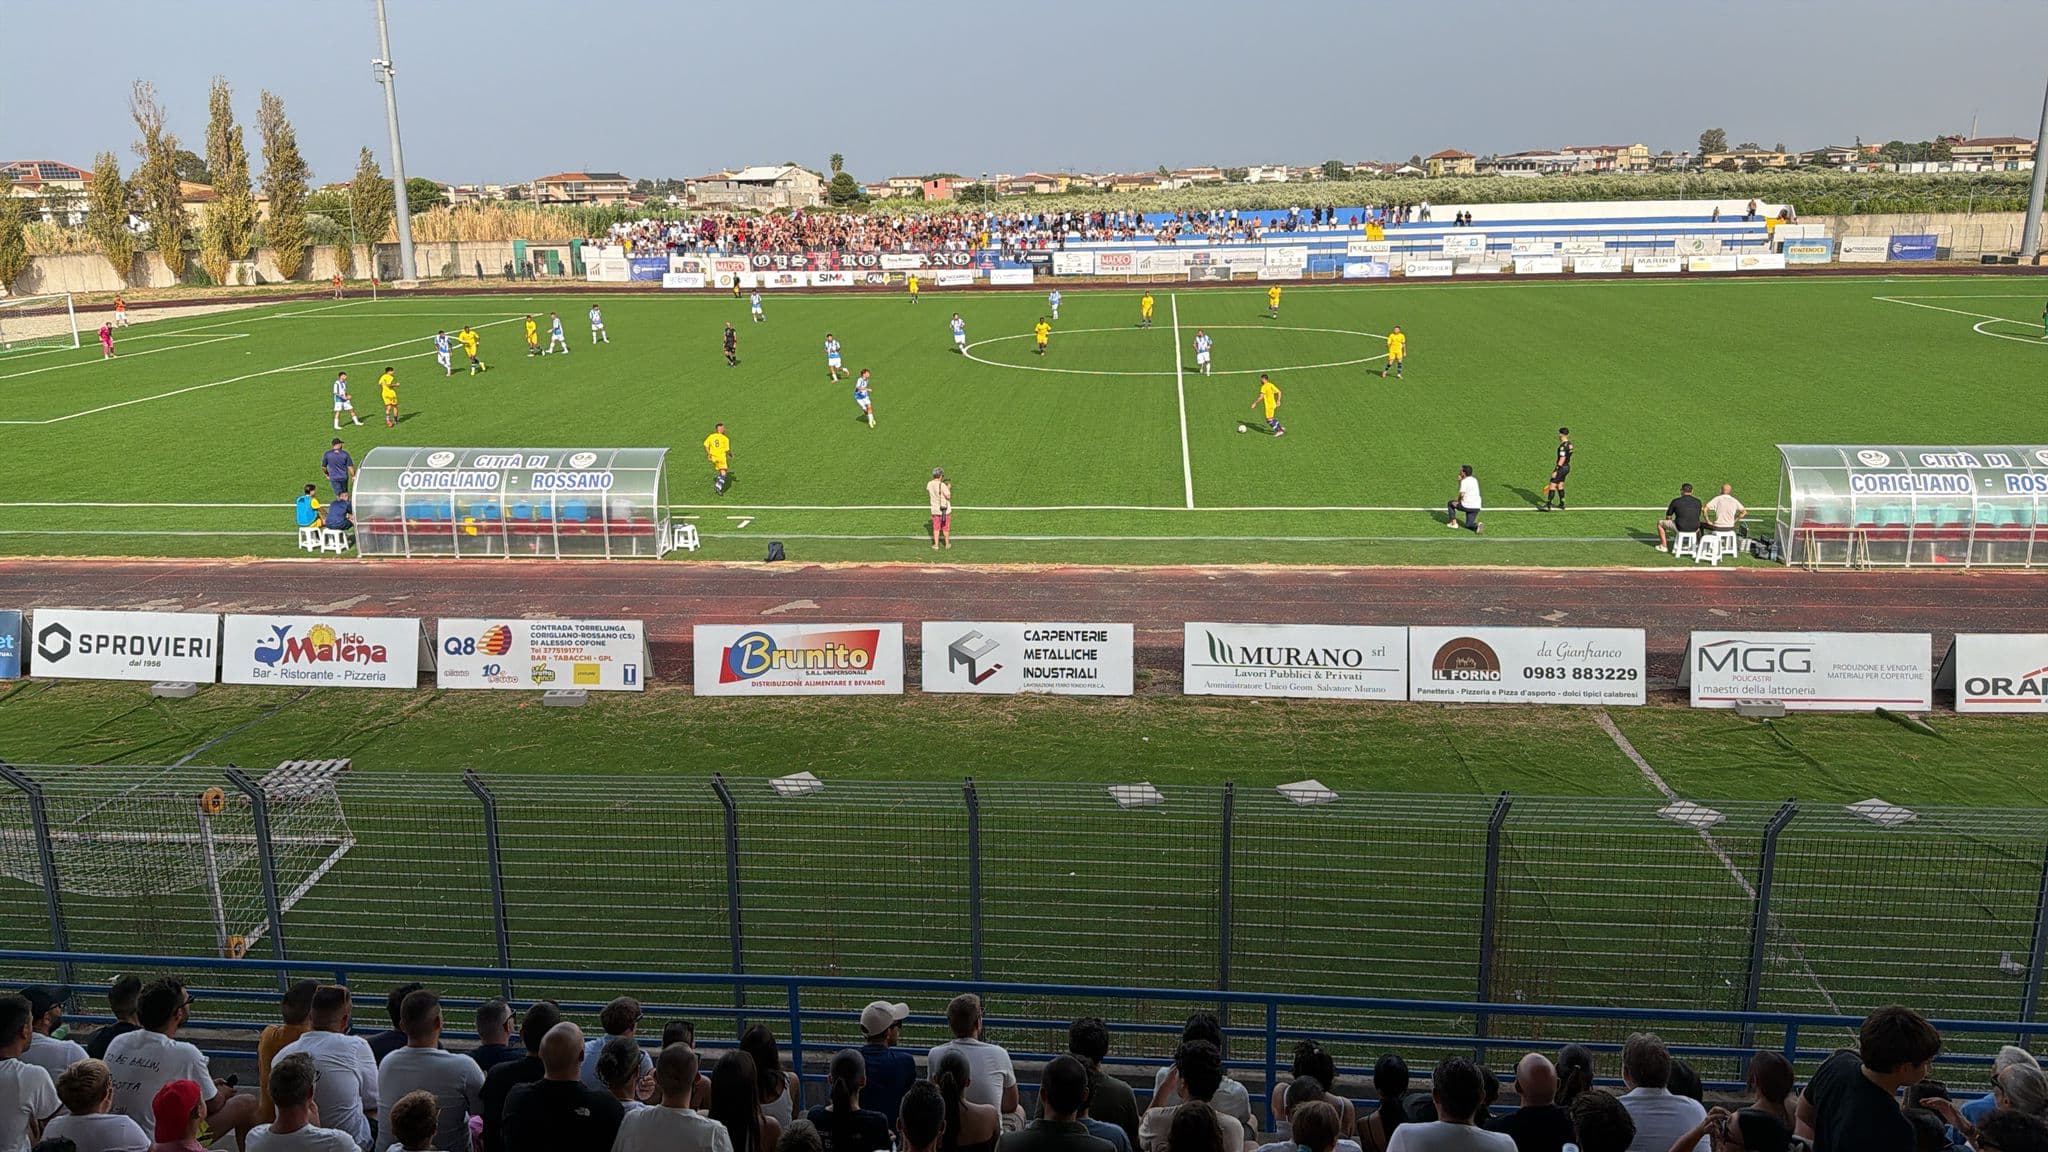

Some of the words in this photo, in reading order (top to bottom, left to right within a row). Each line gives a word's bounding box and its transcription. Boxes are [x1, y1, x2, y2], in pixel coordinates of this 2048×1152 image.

[528, 456, 547, 467] DI
[1986, 454, 2010, 467] DI
[399, 473, 498, 489] CORIGLIANO
[532, 473, 612, 489] ROSSANO
[1852, 475, 1969, 492] CORIGLIANO
[530, 624, 573, 632] CONTRADA
[575, 624, 626, 632] TORRELUNGA
[343, 632, 364, 645] lido
[1023, 630, 1108, 642] CARPENTERIE
[79, 634, 211, 658] SPROVIERI
[282, 637, 387, 665] Malena
[444, 637, 475, 656] Q8
[1537, 640, 1552, 657] da
[1556, 640, 1622, 662] Gianfranco
[530, 654, 547, 662] BAR
[553, 654, 592, 662] TABACCHI
[738, 635, 870, 674] Brunito
[1023, 649, 1098, 661] METALLICHE
[1240, 646, 1363, 668] MURANO
[1371, 645, 1386, 657] srl
[1698, 647, 1816, 673] M.G.G.
[129, 659, 142, 667] dal
[143, 660, 161, 668] 1956
[482, 663, 501, 677] 10
[1832, 663, 1879, 671] PRODUZIONE
[253, 668, 270, 678] Bar
[280, 669, 334, 680] Ristorante
[344, 670, 386, 681] Pizzeria
[1023, 667, 1097, 679] INDUSTRIALI
[1234, 668, 1267, 678] Lavori
[1270, 669, 1311, 680] Pubblici
[1314, 671, 1323, 680] &
[1325, 671, 1363, 681] Privati
[1433, 671, 1447, 680] IL
[1451, 670, 1500, 681] FORNO
[1523, 666, 1566, 680] 0983
[1572, 667, 1638, 681] 883229
[1827, 672, 1865, 680] MATERIALI
[1865, 672, 1880, 680] PER
[1880, 672, 1924, 680] COPERTURE
[854, 679, 886, 687] BEVANDE
[1204, 680, 1262, 690] Amministratore
[1264, 681, 1287, 691] Unico
[1317, 683, 1353, 693] Salvatore
[1354, 684, 1386, 693] Murano
[1417, 687, 1454, 695] Panetteria
[1461, 688, 1490, 696] Pizzeria
[1520, 689, 1556, 698] d'asporto
[1583, 690, 1601, 699] tipici
[1703, 685, 1739, 694] maestri
[1742, 685, 1765, 695] della
[1768, 686, 1816, 695] lattoneria
